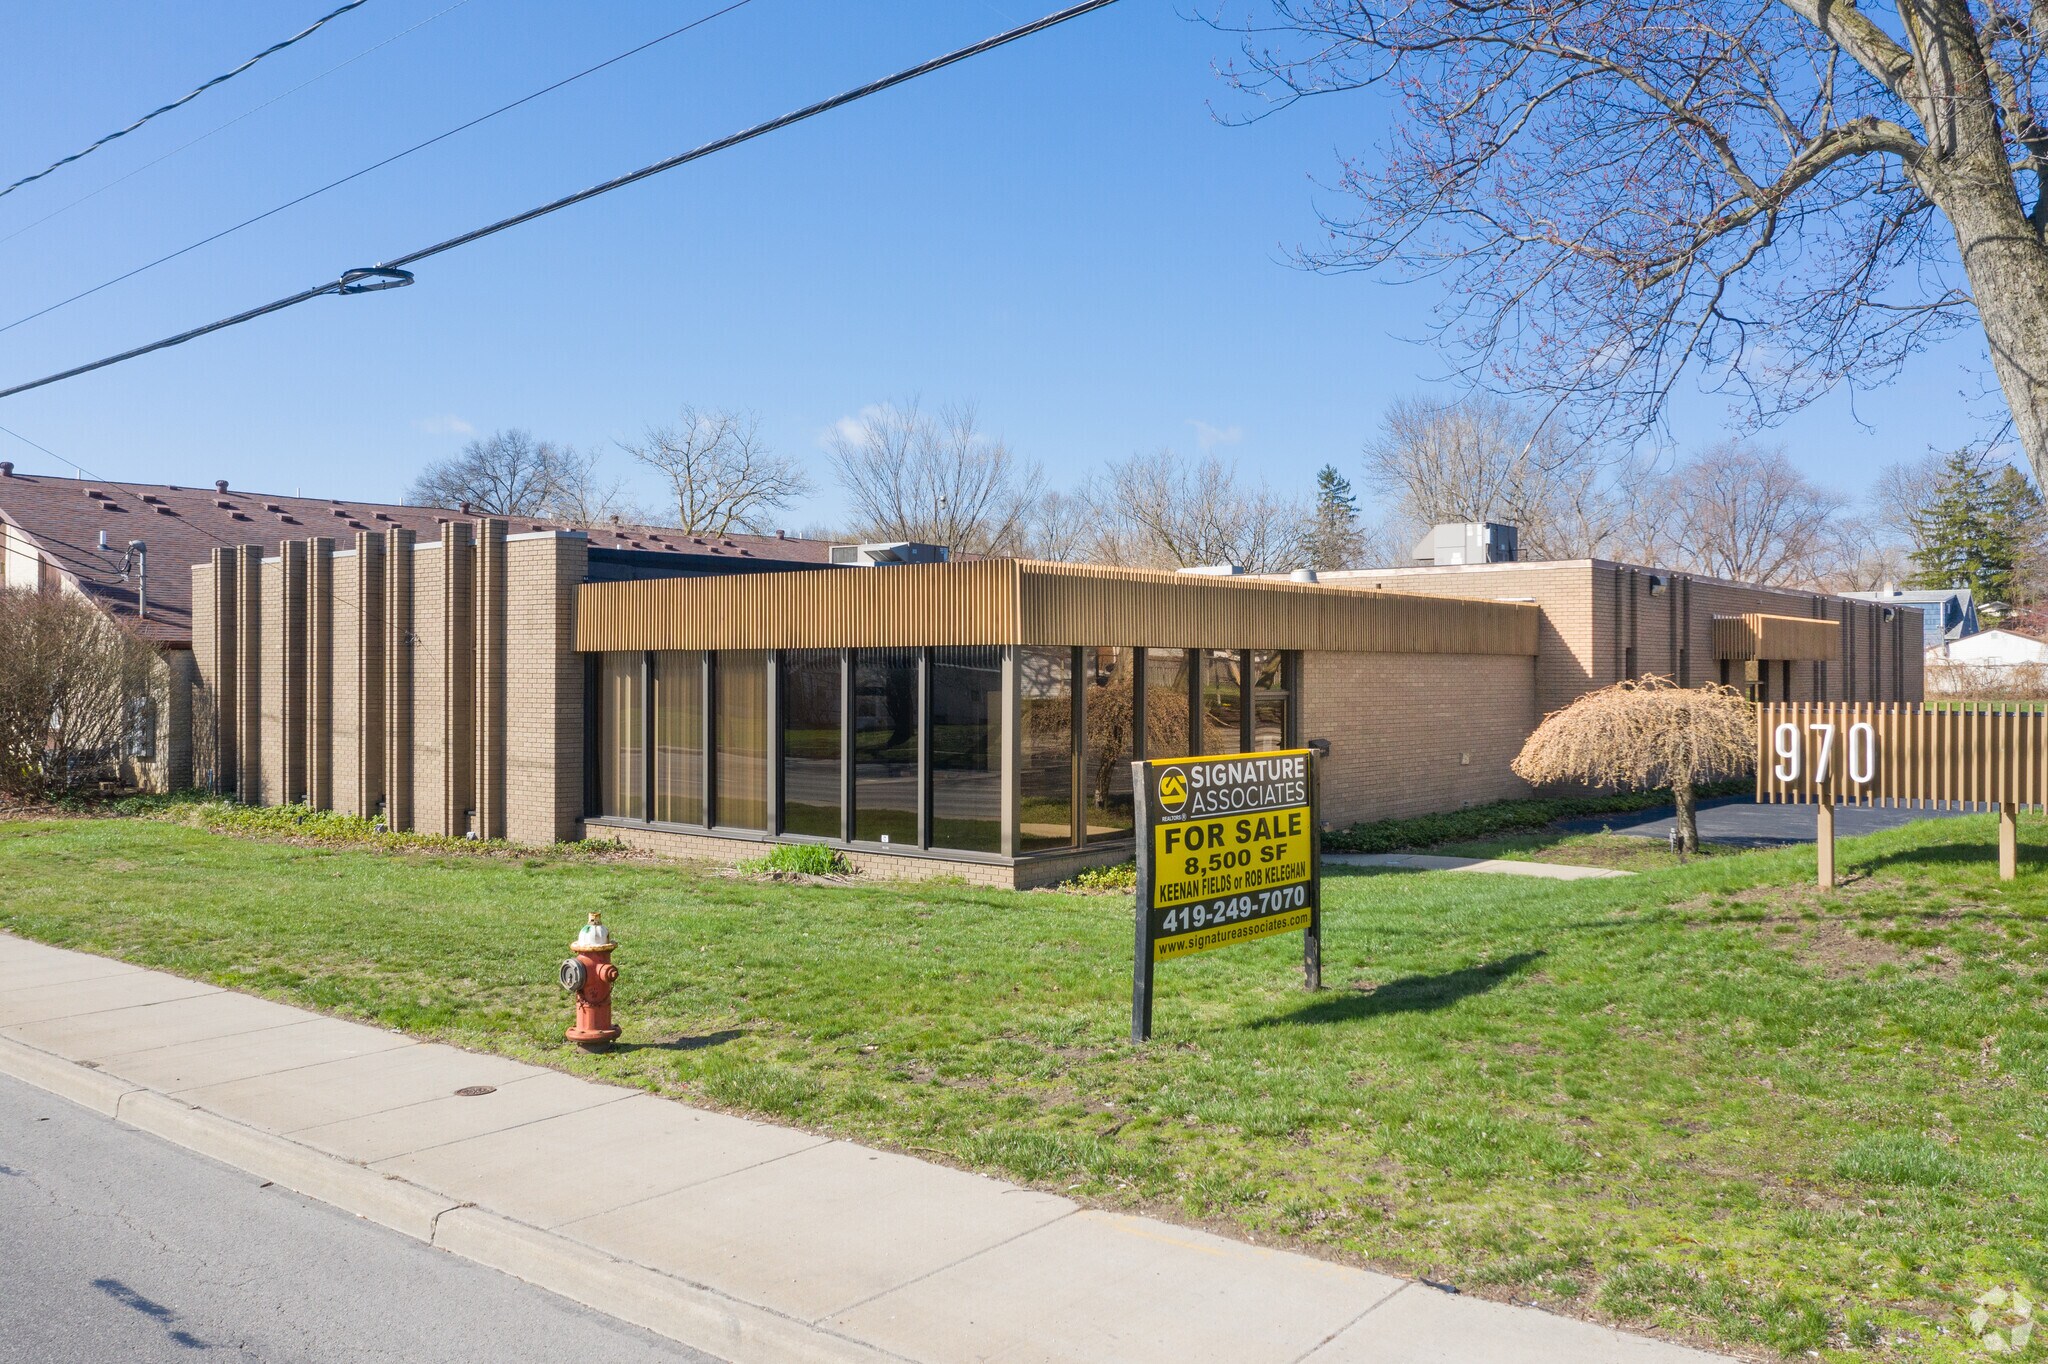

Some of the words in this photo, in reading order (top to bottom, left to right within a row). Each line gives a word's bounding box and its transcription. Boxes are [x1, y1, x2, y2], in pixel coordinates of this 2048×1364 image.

[1191, 757, 1305, 789] SIGNATURE
[1775, 722, 1874, 783] 970
[1192, 781, 1305, 813] ASSOCIATES
[1165, 823, 1224, 854] FOR
[1236, 813, 1301, 844] SALE
[1185, 849, 1250, 877] 8,500
[1260, 844, 1287, 862] SF
[1160, 880, 1199, 902] KEENAN
[1202, 874, 1231, 896] FIELDS
[1234, 875, 1242, 890] or
[1245, 871, 1262, 887] ROB
[1265, 861, 1305, 884] KELEGHAN
[1163, 886, 1305, 932] 419-249-7070
[1159, 913, 1307, 954] www.signatureassociates.com
